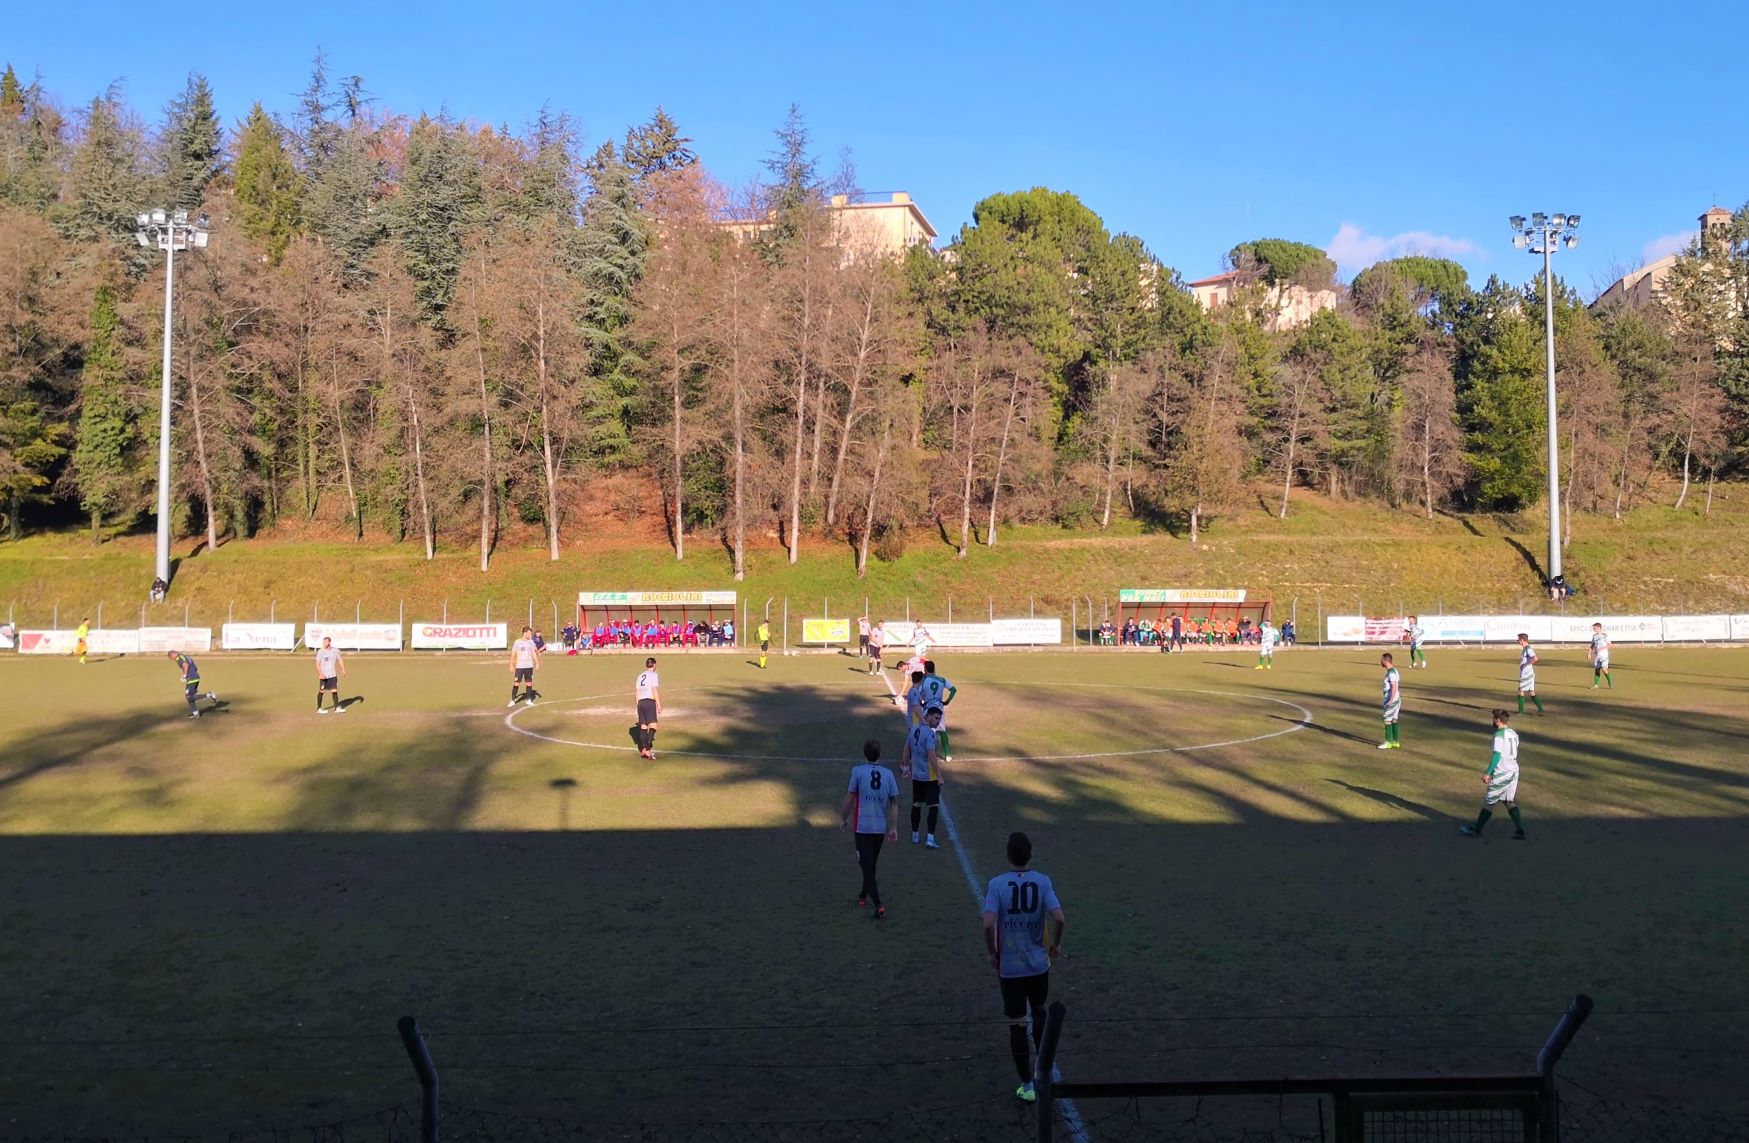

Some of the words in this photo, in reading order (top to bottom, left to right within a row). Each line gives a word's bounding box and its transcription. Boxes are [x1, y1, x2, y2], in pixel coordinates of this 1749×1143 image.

[422, 626, 497, 638] GRAZIOTTI
[640, 673, 647, 687] 2
[930, 681, 939, 696] 9
[914, 727, 921, 746] 9
[870, 769, 882, 790] 8
[1007, 880, 1039, 915] 10
